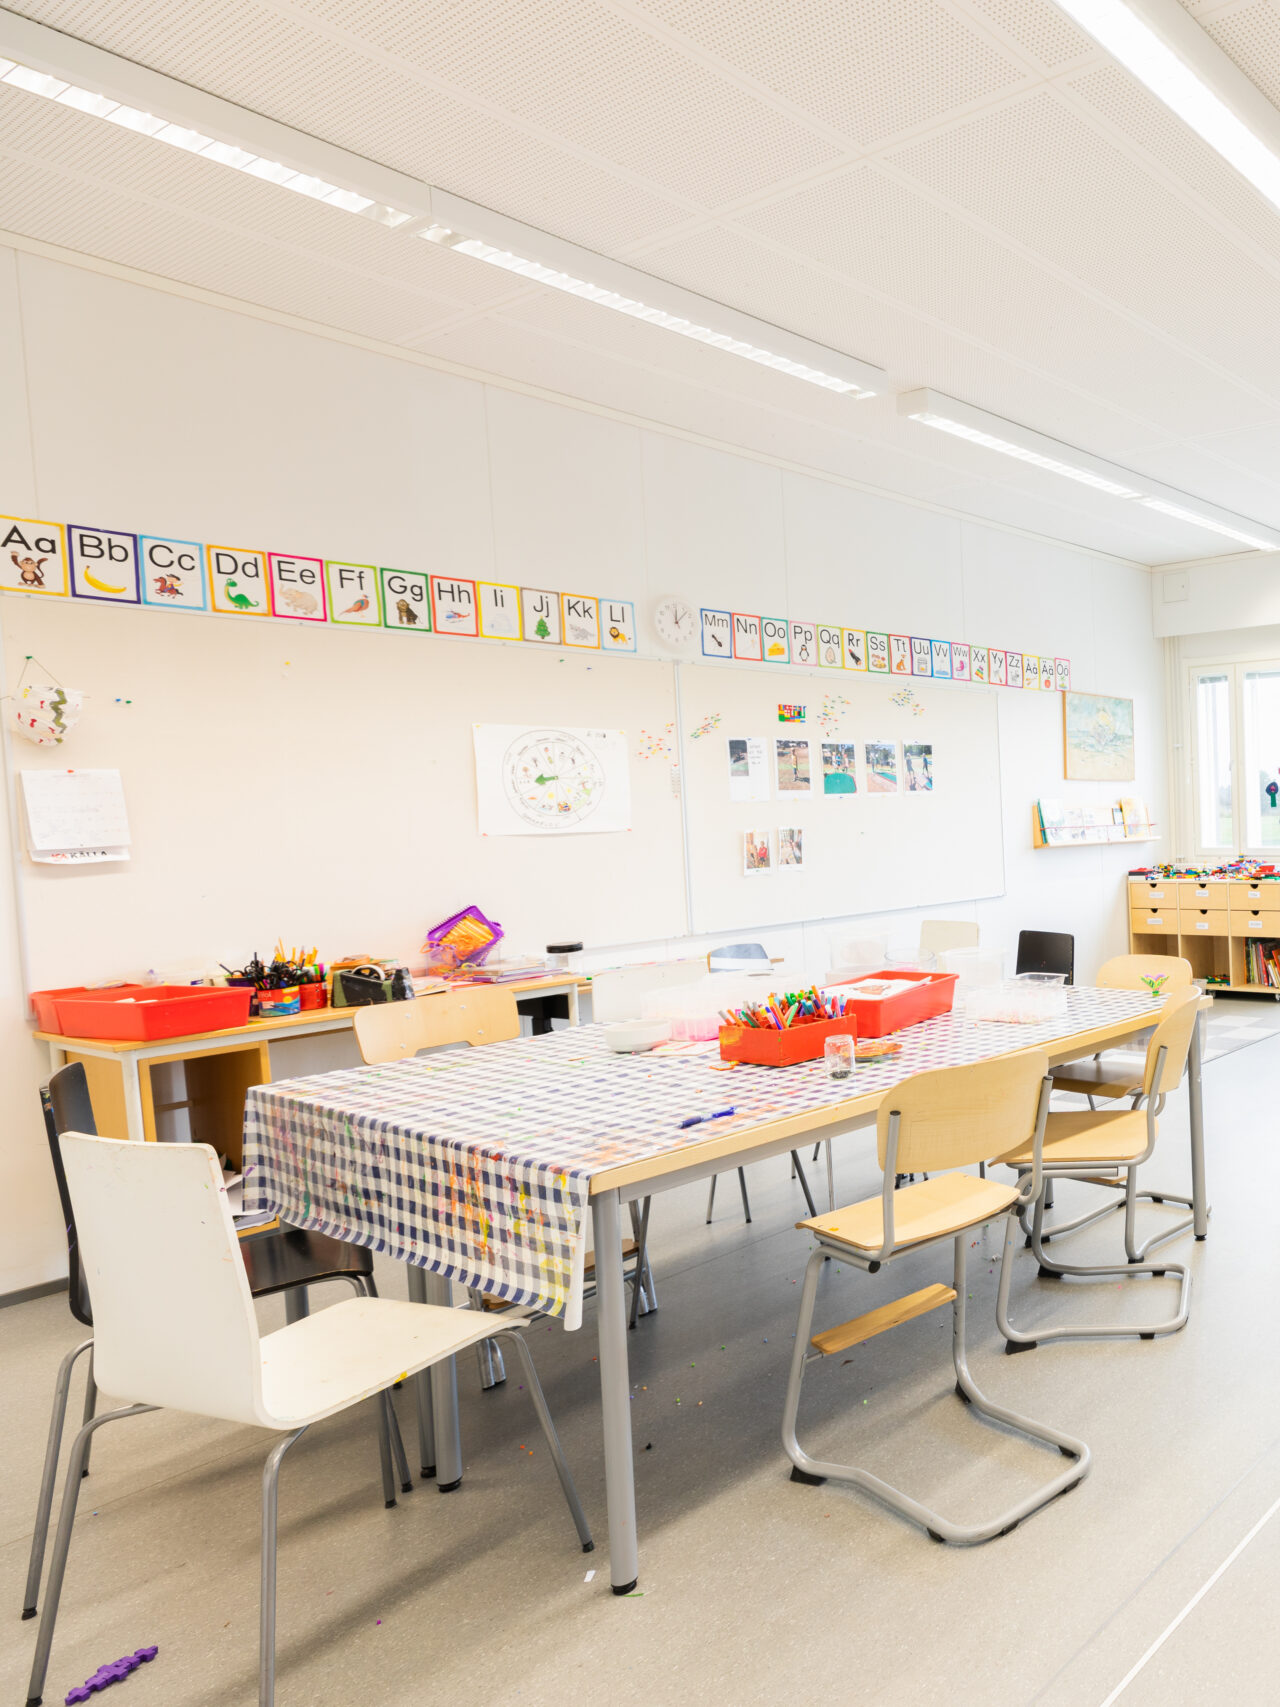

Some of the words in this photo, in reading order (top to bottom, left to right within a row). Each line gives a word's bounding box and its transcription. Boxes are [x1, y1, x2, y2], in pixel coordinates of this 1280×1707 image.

[0, 525, 57, 554] Aa
[78, 533, 129, 563] Bb
[148, 544, 196, 572] Cc
[215, 552, 260, 578] Dd
[277, 560, 316, 585] Ee
[339, 568, 365, 591] Ff
[387, 576, 423, 602] Gg
[437, 582, 471, 604] Hh
[493, 589, 504, 607] Ii
[533, 596, 549, 618] Jj
[567, 599, 593, 619] Kk
[609, 605, 625, 623] Ll
[704, 614, 729, 628] Mm
[736, 617, 758, 635] Nn
[764, 622, 786, 639] Oo
[793, 625, 813, 644] Pp
[820, 629, 840, 648] Qq
[848, 633, 861, 647] Rr
[869, 636, 886, 651] Ss
[893, 639, 907, 653] Tt
[913, 642, 930, 656] Uu
[933, 644, 948, 658] Vv
[953, 646, 968, 658] Ww
[973, 649, 986, 664] Xx
[991, 652, 1004, 666] Yy
[1008, 655, 1020, 669] Zz
[1025, 658, 1038, 675] Åå
[1041, 660, 1054, 676] Ää
